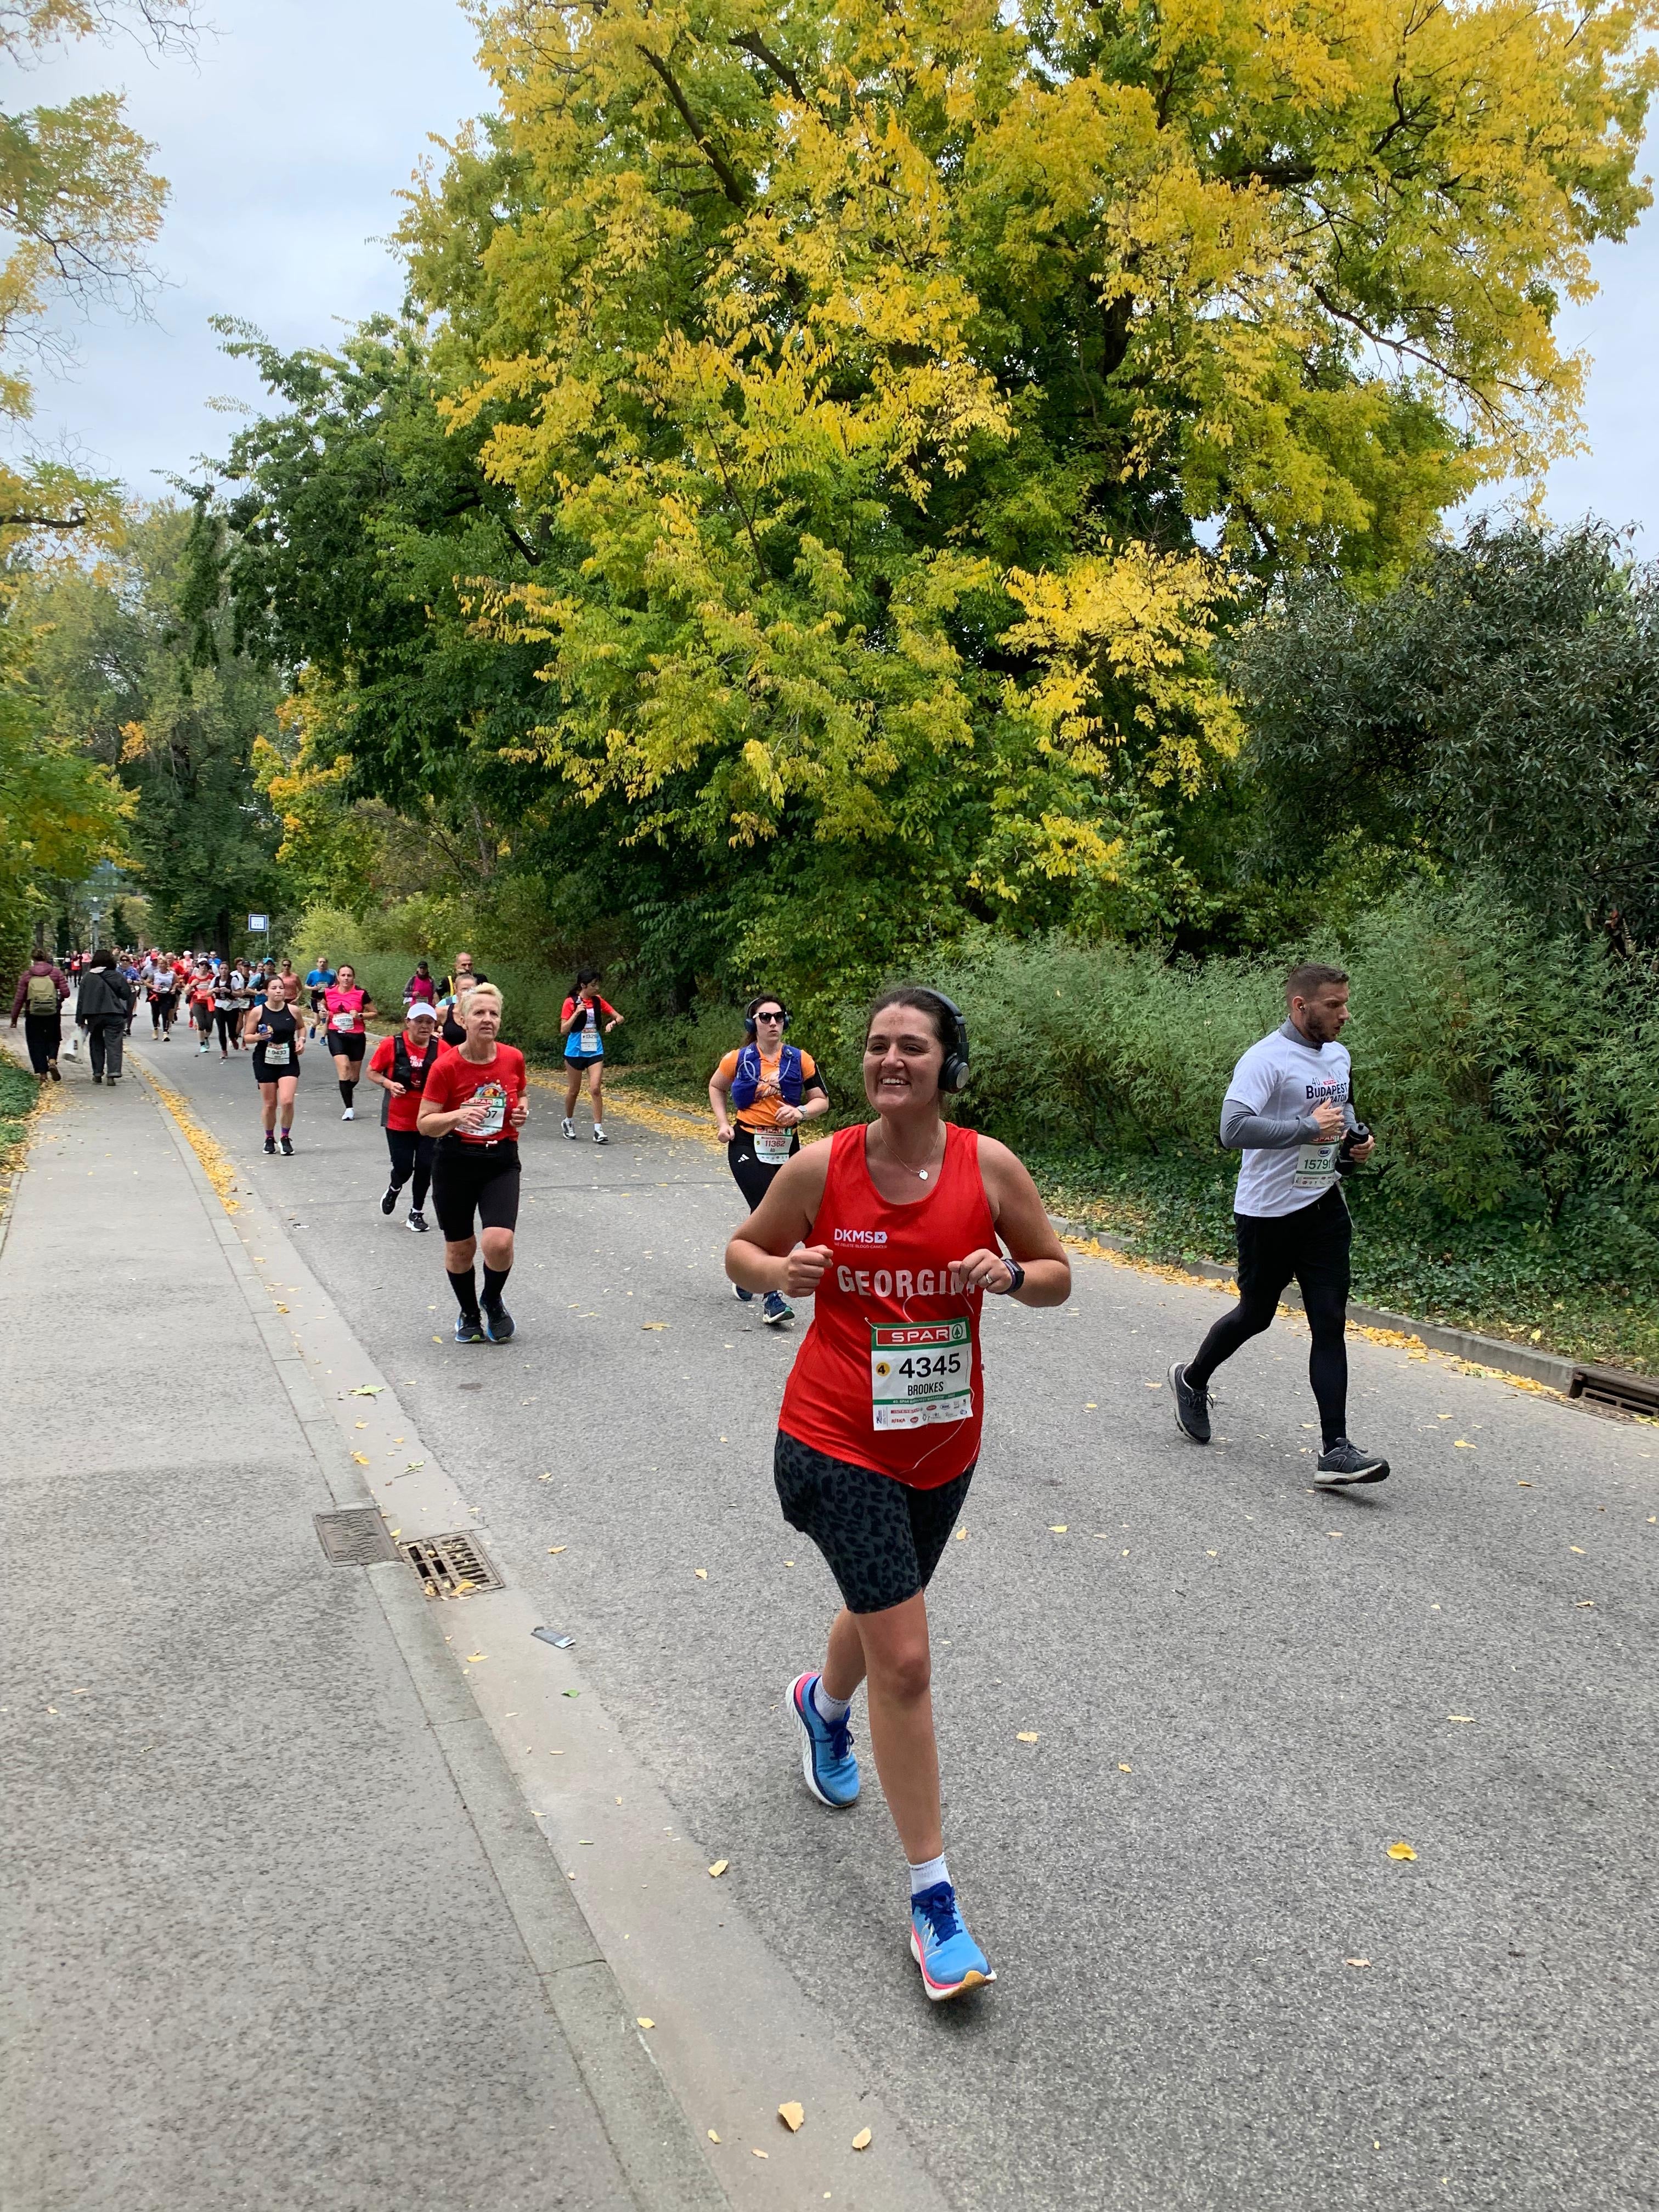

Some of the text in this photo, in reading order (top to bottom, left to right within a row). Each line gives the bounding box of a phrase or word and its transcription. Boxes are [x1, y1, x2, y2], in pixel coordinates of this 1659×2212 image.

[1306, 1082, 1347, 1099] BUDAPEST
[1319, 1094, 1347, 1105] MRATON
[834, 1228, 874, 1244] DKMS
[891, 1329, 949, 1342] SPAR
[878, 1352, 961, 1379] 4 4345
[907, 1381, 944, 1396] BROOKES
